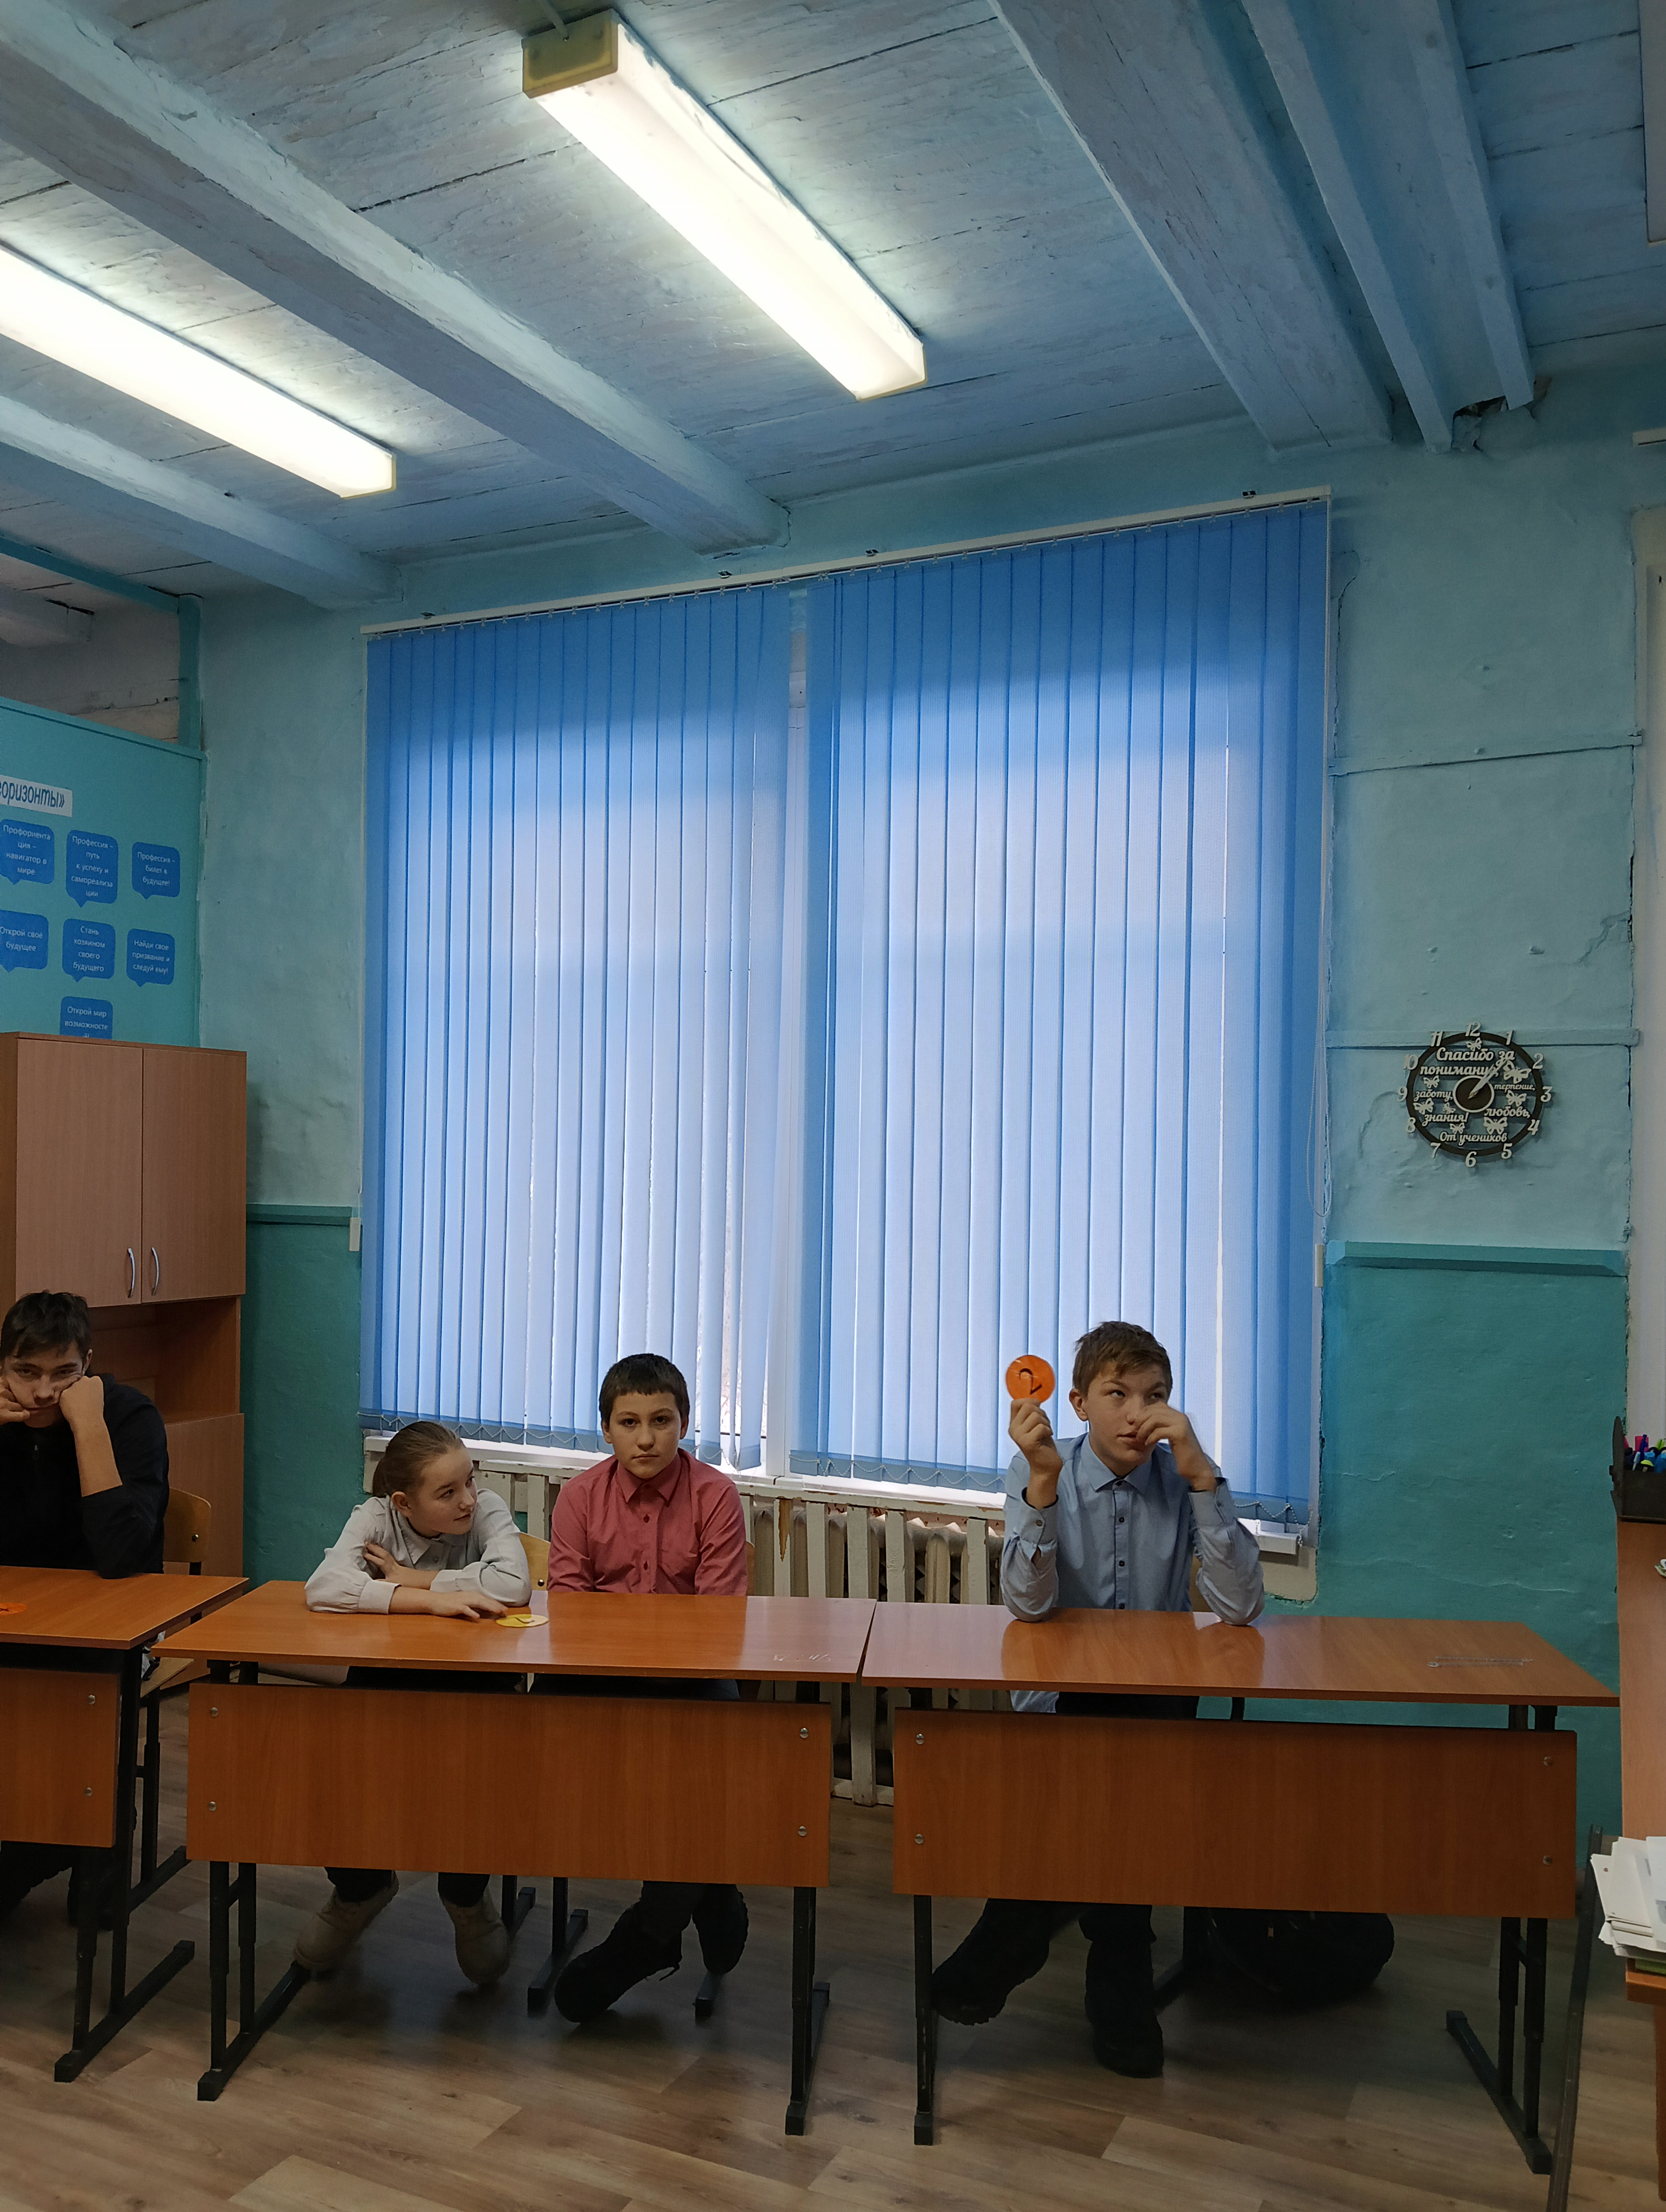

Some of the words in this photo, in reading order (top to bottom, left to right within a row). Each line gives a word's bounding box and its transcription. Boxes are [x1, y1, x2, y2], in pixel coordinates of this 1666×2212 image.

[0, 781, 65, 808] оризонты»
[3, 825, 50, 840] Профориента
[73, 836, 108, 848] Профессия
[6, 852, 41, 864] навигатор
[137, 852, 170, 863] Профессия
[82, 864, 103, 874] успеху
[145, 865, 162, 873] билет
[71, 876, 113, 888] самореализа
[143, 876, 170, 886] будущее!
[0, 926, 25, 936] Открой
[80, 926, 99, 935] Стань
[6, 941, 36, 951] будущее
[74, 939, 105, 948] хозяином
[134, 940, 153, 949] Найди
[132, 952, 164, 962] призвание
[73, 961, 104, 972] будущего
[133, 964, 153, 973] следуй
[67, 1006, 91, 1016] Открой
[65, 1021, 108, 1030] возможносте
[1465, 1021, 1481, 1036] 12
[1431, 1031, 1443, 1046] 11
[1505, 1030, 1513, 1045] 1
[1404, 1054, 1418, 1070] 10
[1437, 1047, 1494, 1061] Спасибо
[1496, 1051, 1515, 1066] за
[1533, 1053, 1543, 1069] 2
[1398, 1086, 1407, 1102] 9
[1414, 1089, 1453, 1102] заботу,
[1540, 1086, 1552, 1102] 3
[1484, 1106, 1530, 1118] любовь,
[1406, 1117, 1416, 1133] 8
[1422, 1111, 1469, 1127] знания!
[1528, 1120, 1540, 1135] 4
[1440, 1132, 1457, 1142] От
[1458, 1132, 1508, 1146] учеников
[1431, 1142, 1440, 1158] 7
[1501, 1143, 1513, 1159] 5
[1465, 1152, 1477, 1167] 6
